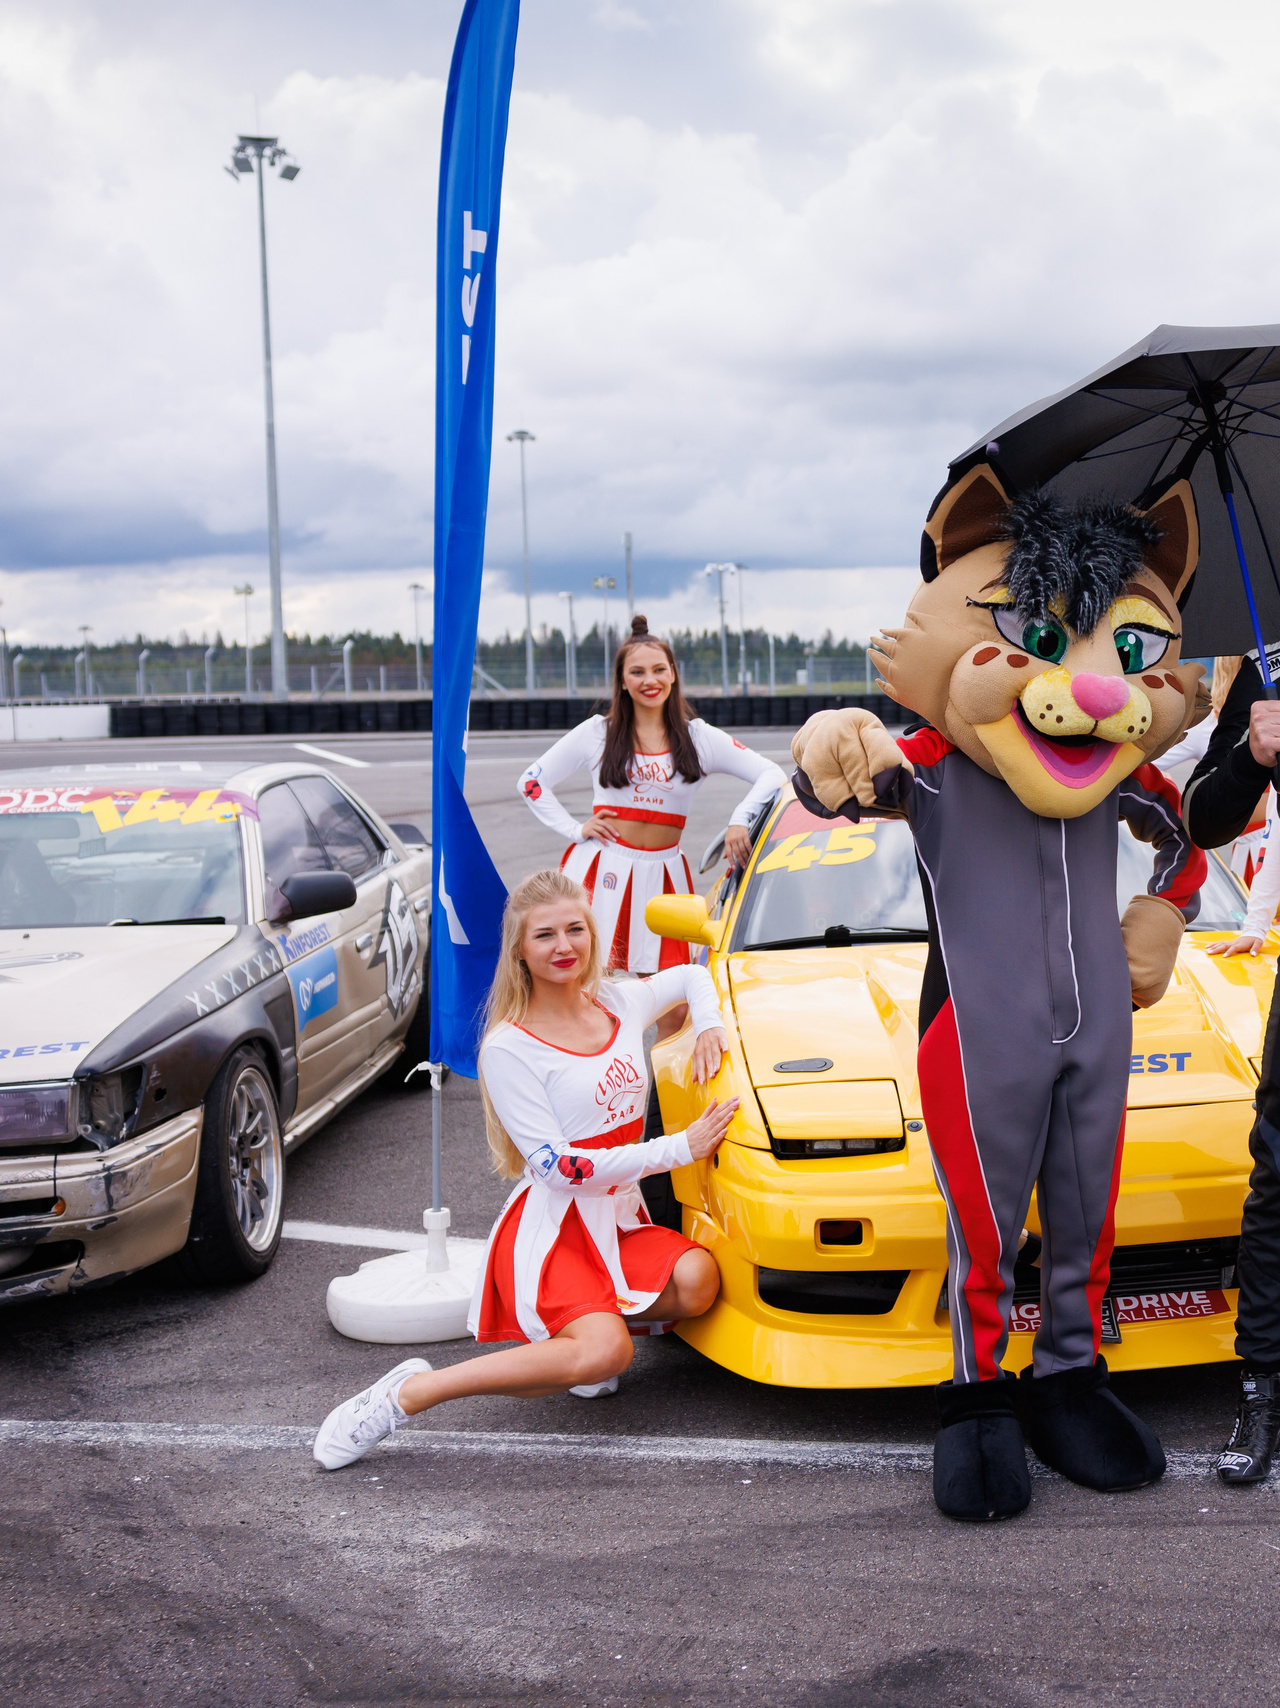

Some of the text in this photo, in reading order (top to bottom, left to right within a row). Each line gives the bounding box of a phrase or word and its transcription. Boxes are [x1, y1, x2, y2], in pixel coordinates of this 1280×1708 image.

[80, 788, 242, 833] 144
[633, 796, 664, 805] ДРАЙВ
[756, 823, 876, 875] 45
[277, 922, 332, 962] KINFOREST
[1117, 1290, 1210, 1311] DRIVE
[1117, 1304, 1215, 1322] ALLENGE
[1217, 1456, 1248, 1466] OMP
